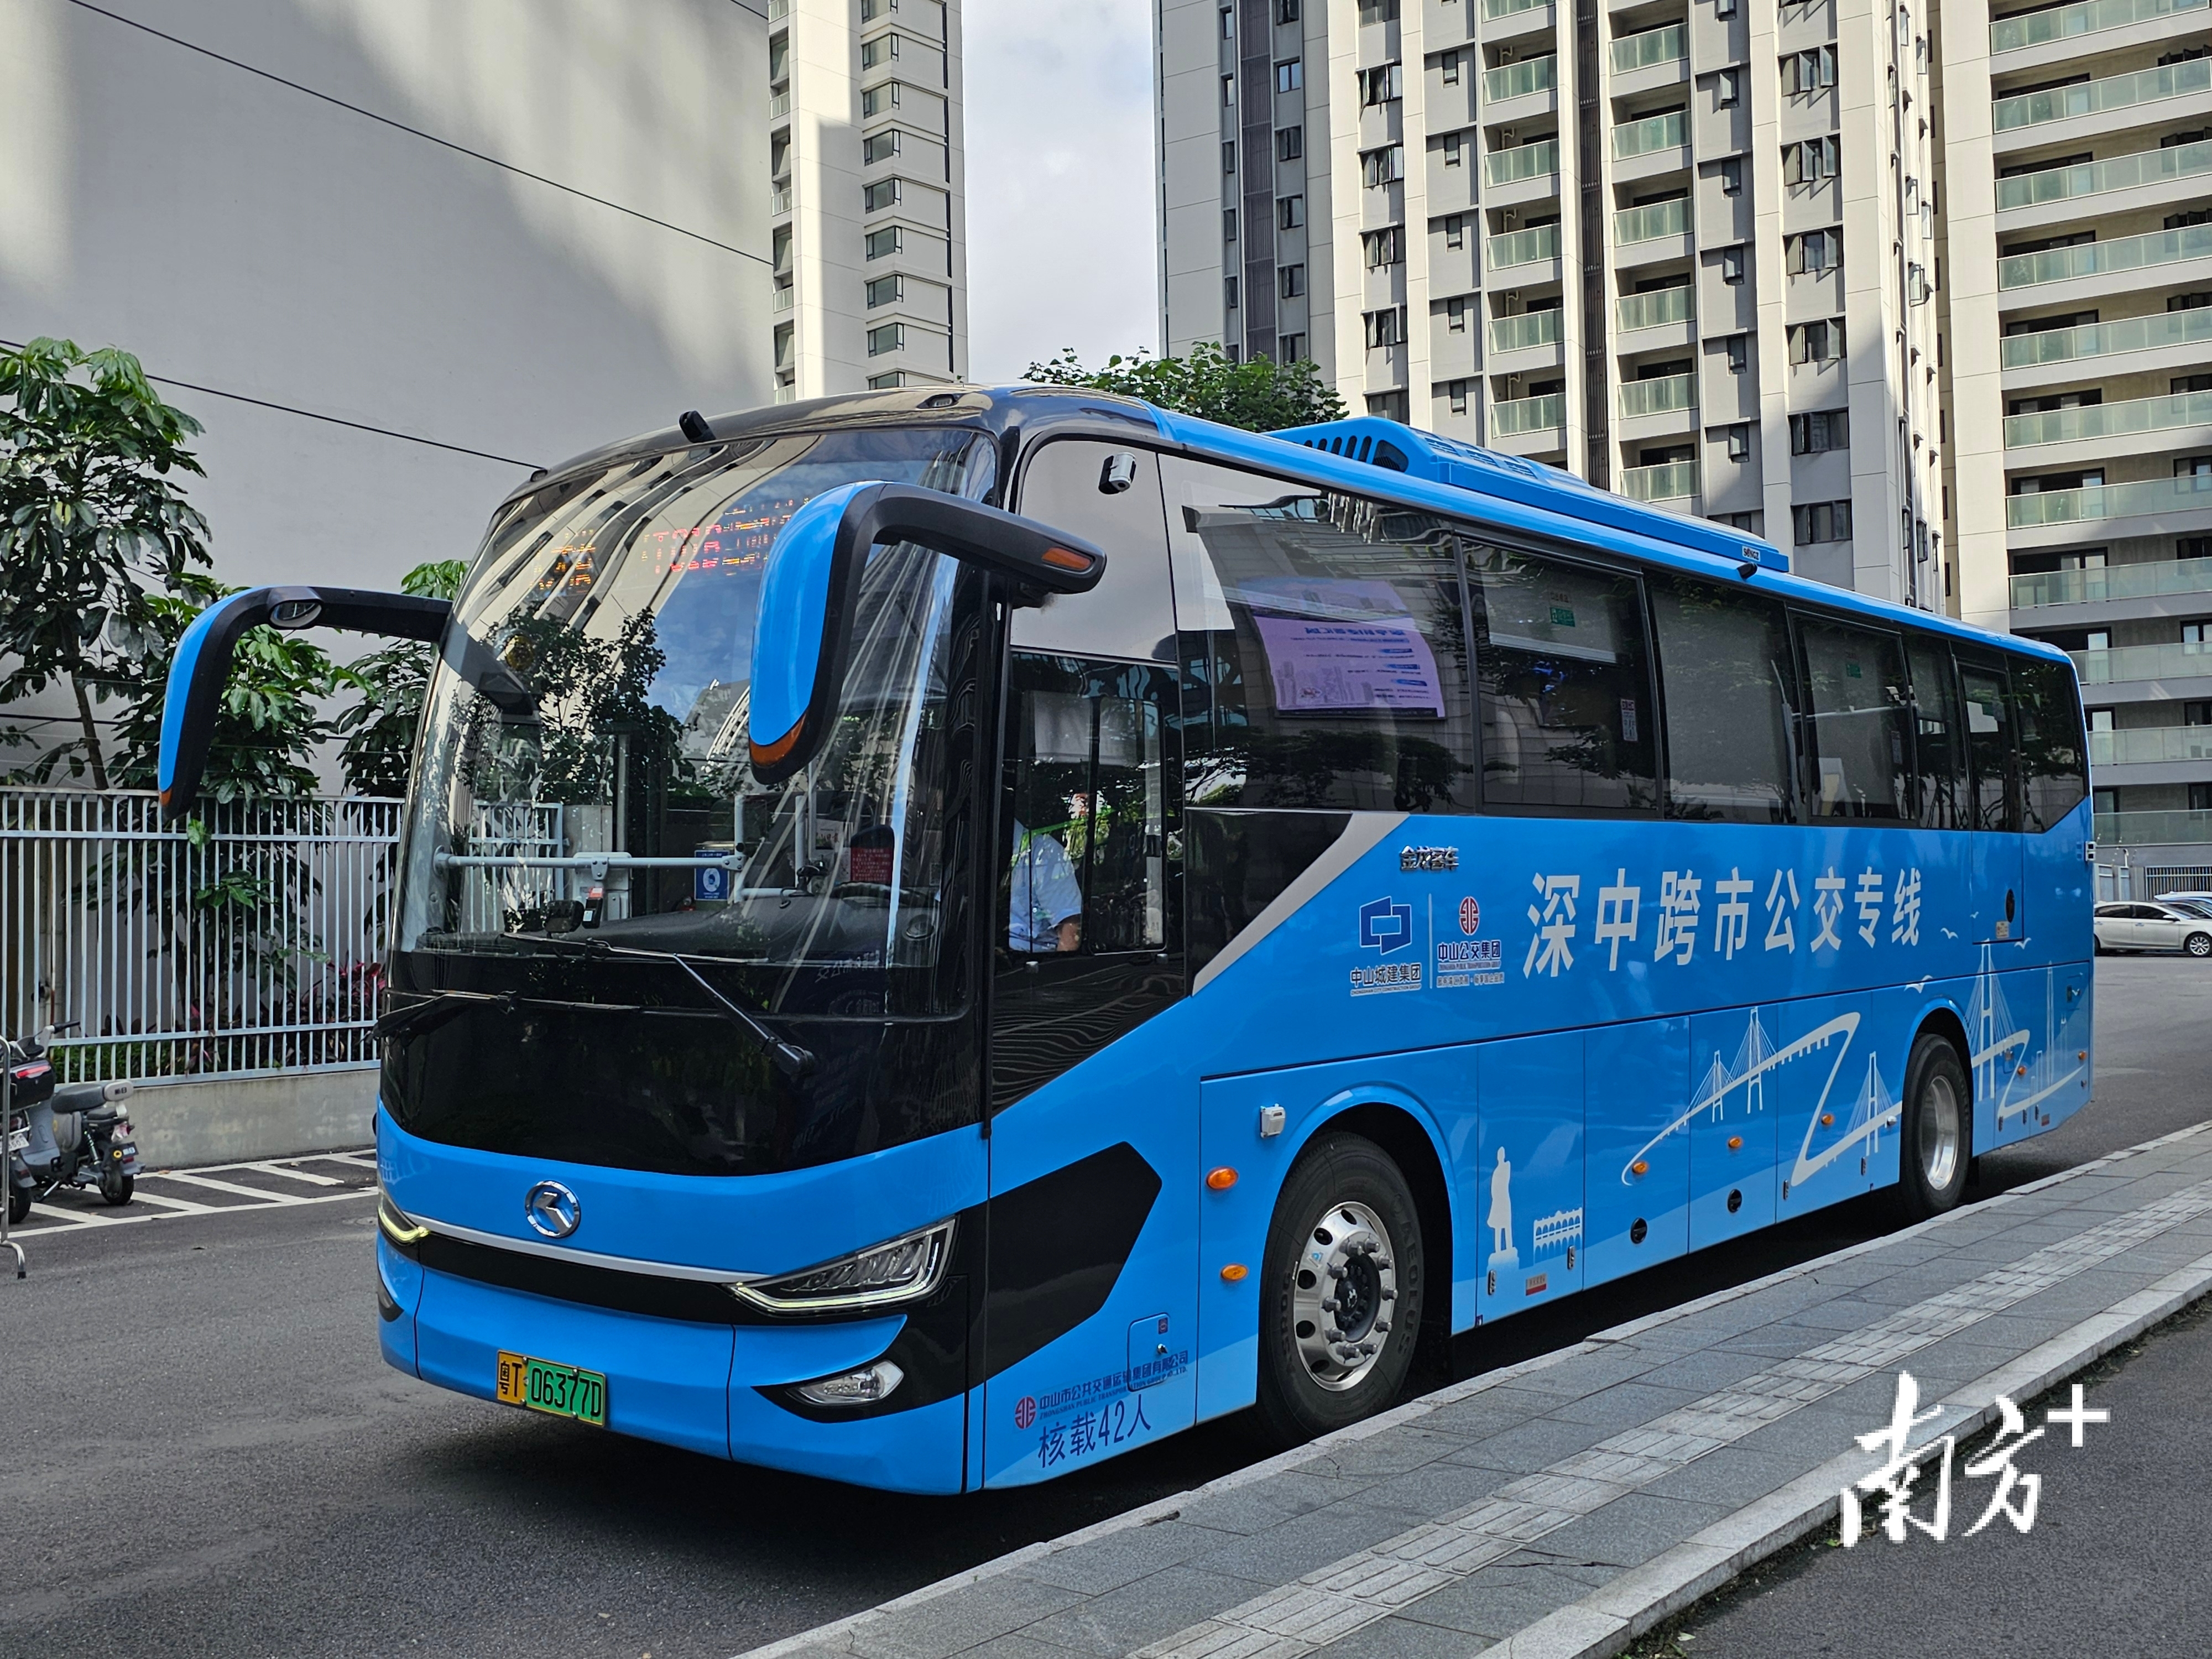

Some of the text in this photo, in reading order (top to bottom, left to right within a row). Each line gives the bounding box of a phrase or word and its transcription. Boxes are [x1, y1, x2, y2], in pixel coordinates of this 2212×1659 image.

[1438, 940, 1501, 961] 中山公交集团
[1522, 865, 1923, 979] 深中跨市公交专线
[1350, 963, 1422, 987] 中山城建集团
[1397, 1221, 1418, 1355] AEOLUS
[1040, 1349, 1188, 1410] 中山市公共交通运输集团有限公司
[1040, 1402, 1074, 1420] ZHONGSHAN
[1076, 1394, 1096, 1408] PUBLIC
[1038, 1394, 1151, 1468] 核载42人
